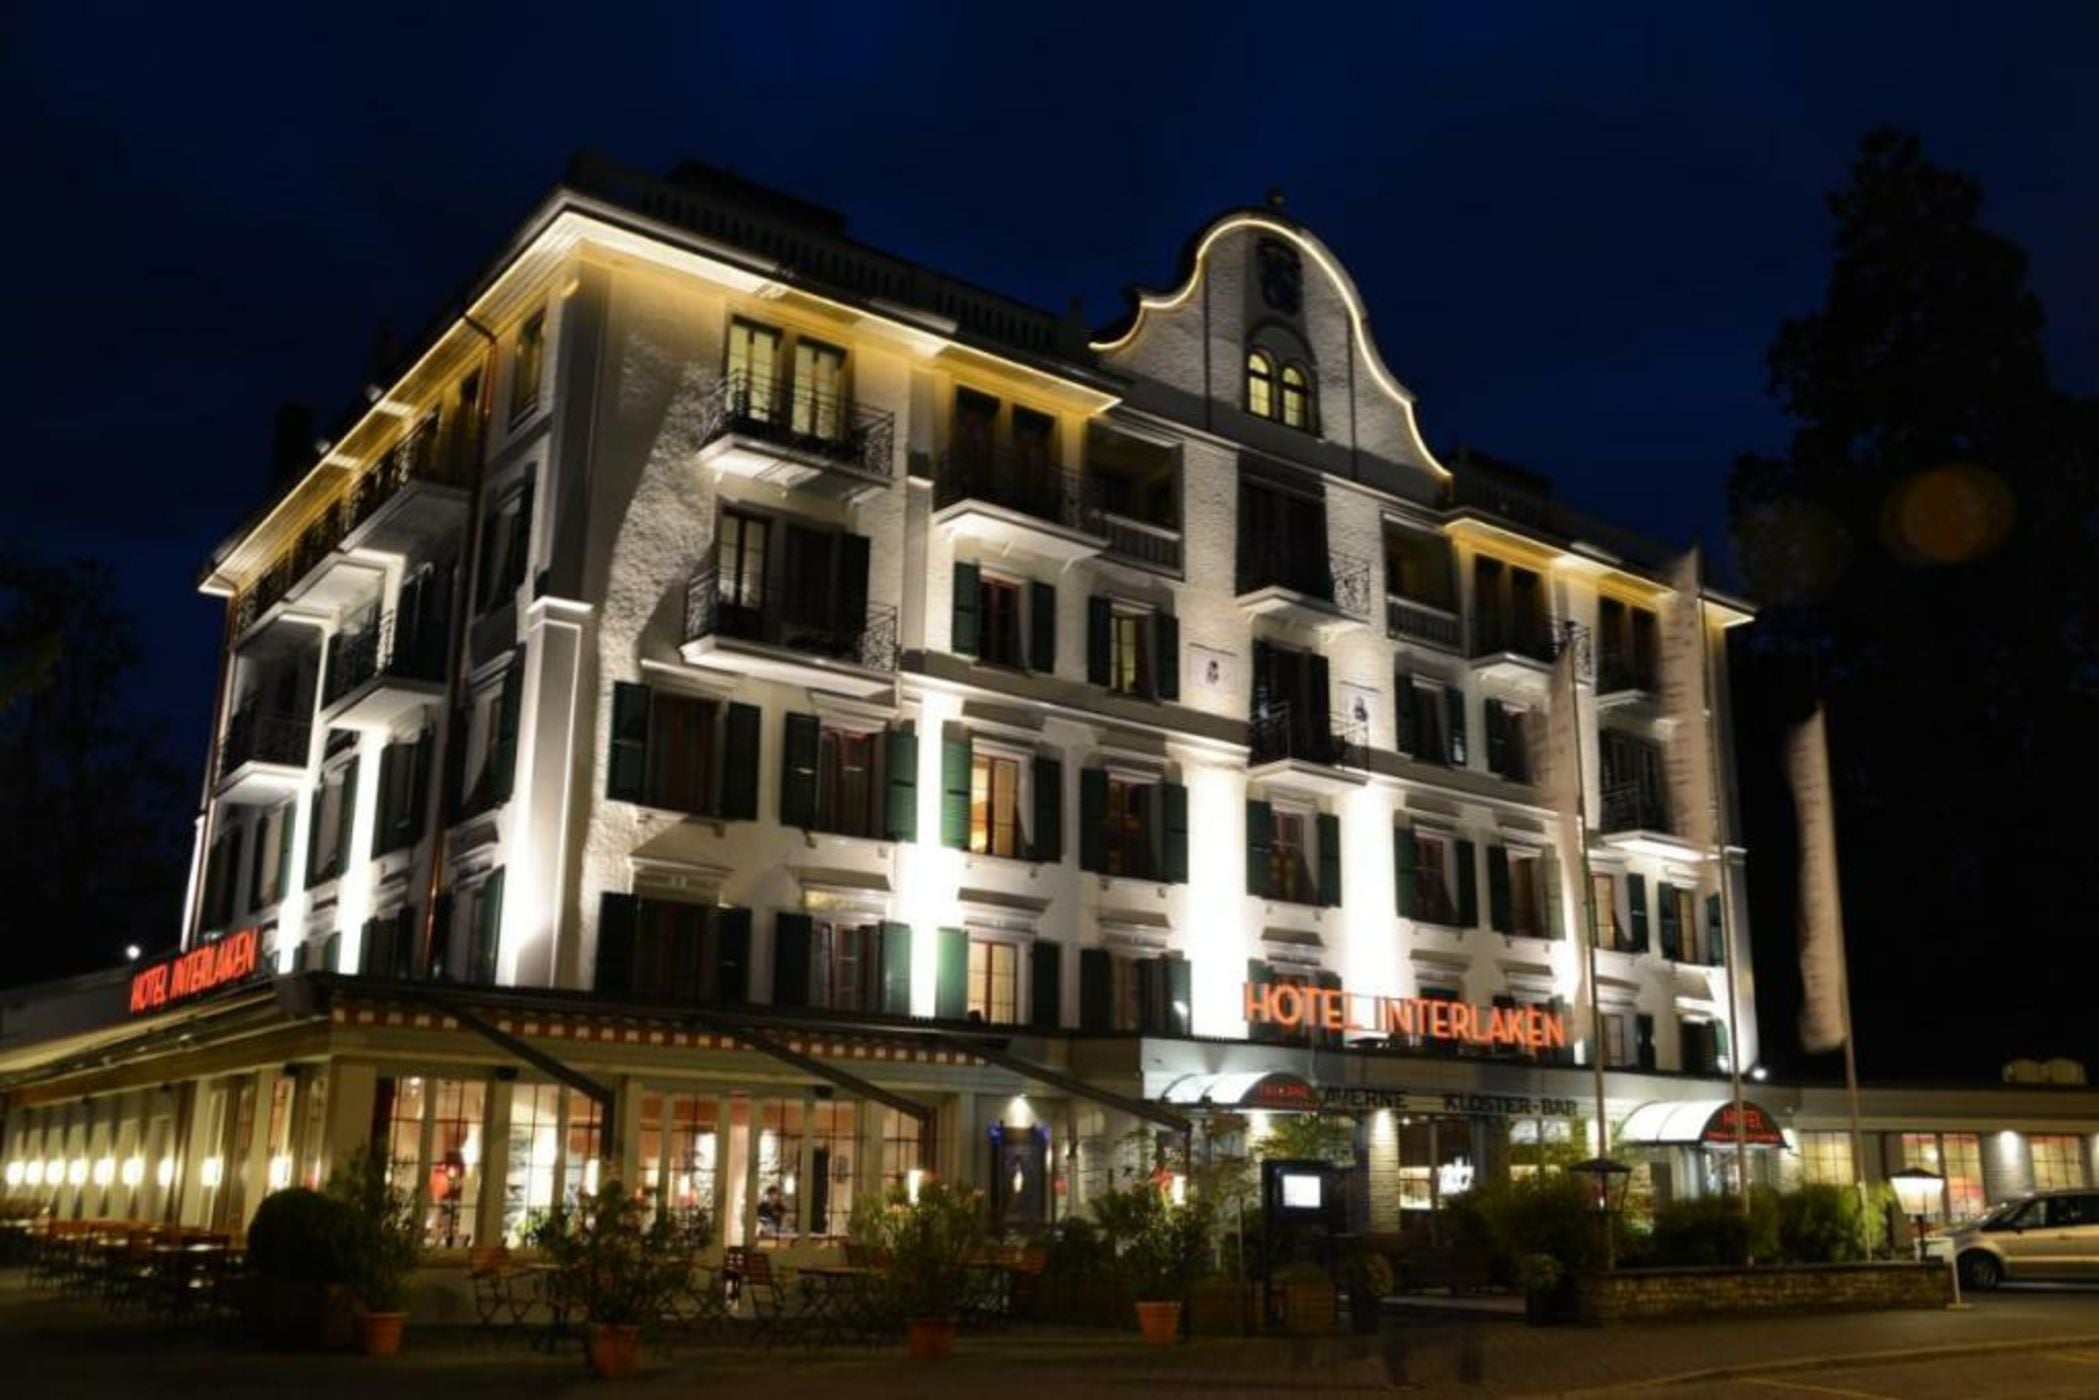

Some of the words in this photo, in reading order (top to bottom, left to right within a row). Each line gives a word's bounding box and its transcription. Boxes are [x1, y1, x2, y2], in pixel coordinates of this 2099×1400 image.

[130, 963, 168, 1013] HOTEL
[169, 927, 258, 999] INTERLAKEN
[1244, 984, 1361, 1029] HOTEL
[1379, 997, 1566, 1047] INTERLAKEN
[1319, 1085, 1408, 1109] AVERNE
